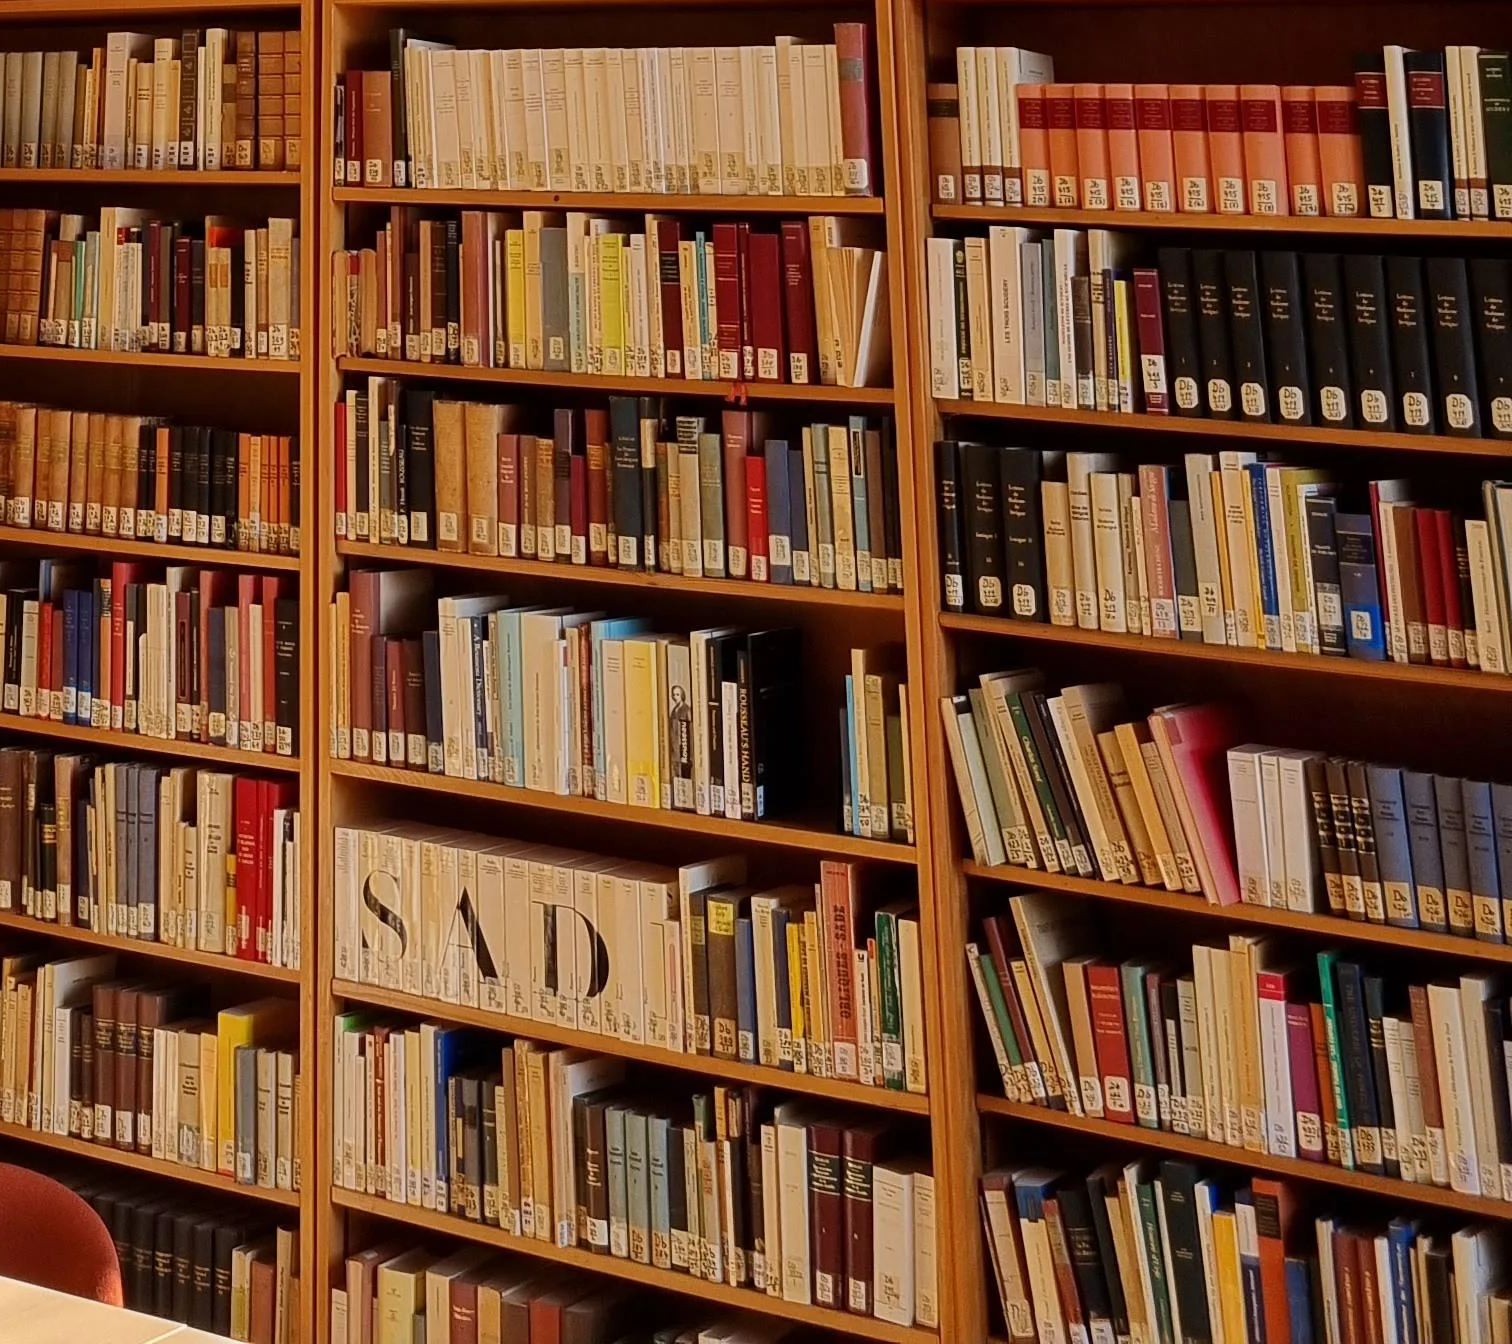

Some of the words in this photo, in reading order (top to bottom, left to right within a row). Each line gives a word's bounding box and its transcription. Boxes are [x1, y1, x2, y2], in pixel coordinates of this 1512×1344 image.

[1179, 380, 1193, 390] Db
[1212, 381, 1225, 393] Db
[1245, 385, 1258, 395] Db
[1284, 389, 1297, 399] Db
[1325, 389, 1338, 400] Db
[1367, 393, 1379, 403] Db
[1408, 396, 1422, 406] Db
[1452, 397, 1466, 408] Db
[1496, 399, 1510, 410] Db
[946, 577, 958, 587] Db
[982, 578, 995, 589] Db
[1016, 586, 1029, 597] Db
[1104, 589, 1116, 601] Db
[739, 687, 749, 750] ROUSSEAU'S
[680, 720, 688, 762] Rousseau
[741, 751, 751, 784] HAND
[361, 870, 610, 998] SAD
